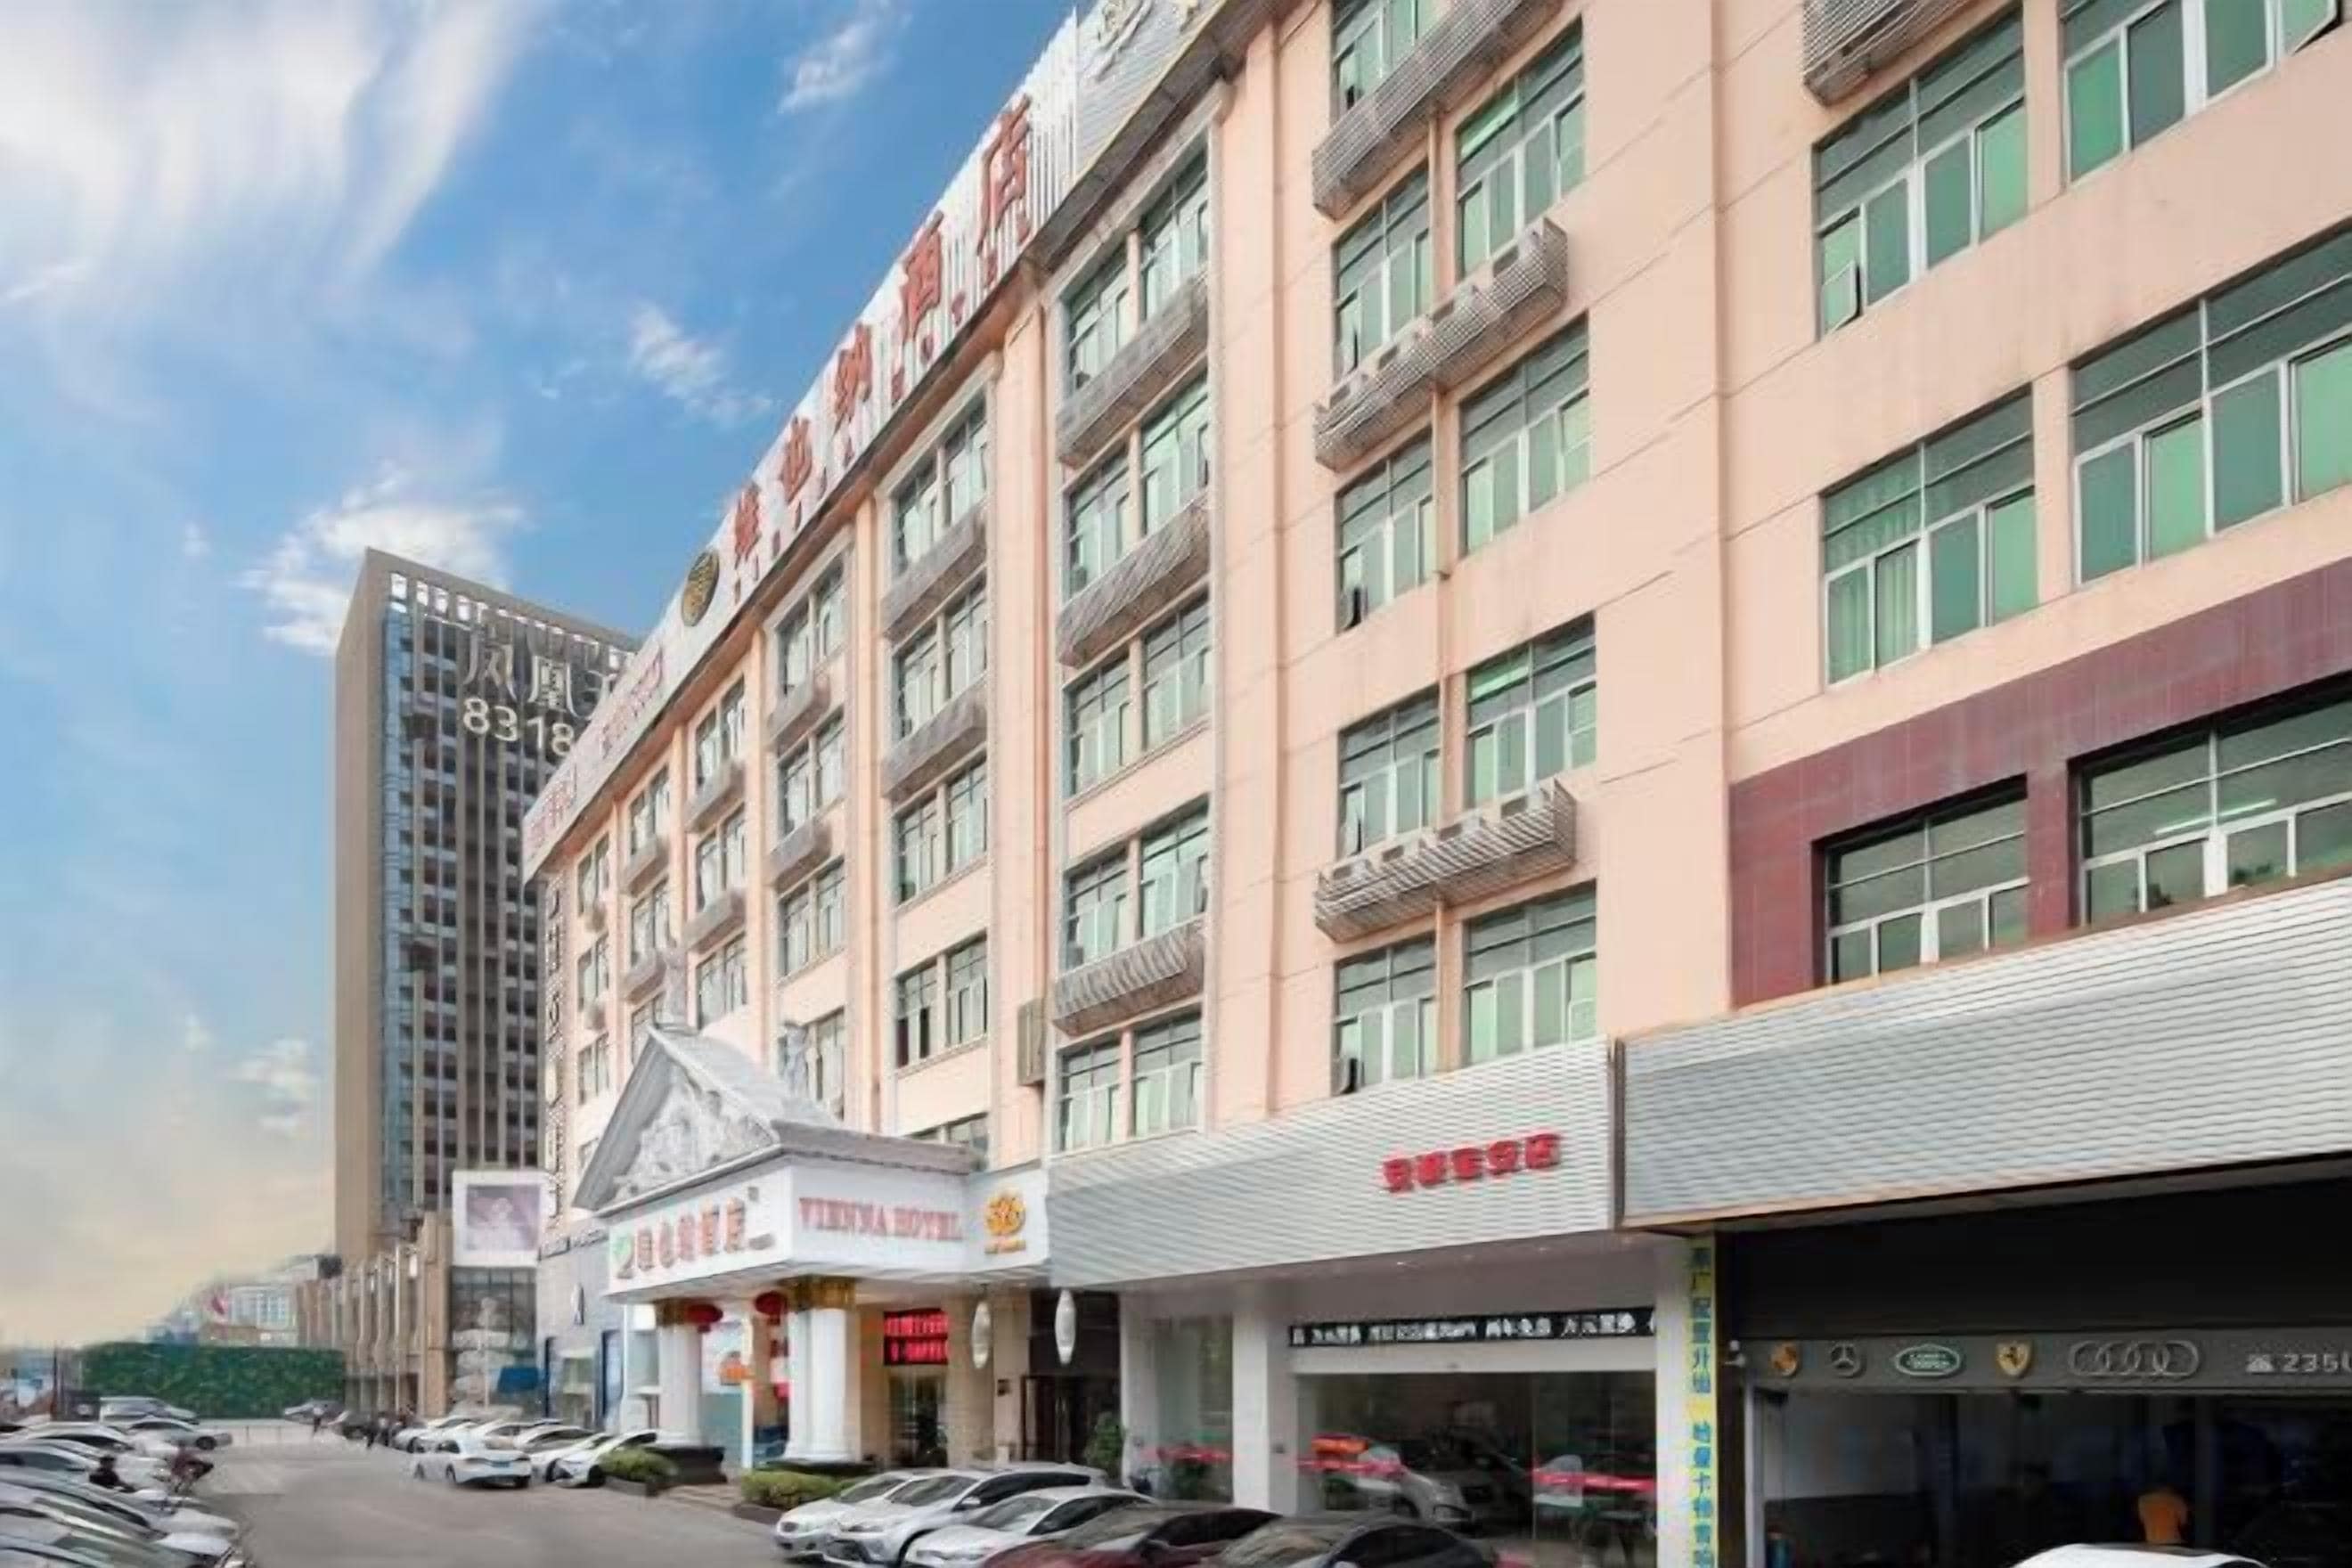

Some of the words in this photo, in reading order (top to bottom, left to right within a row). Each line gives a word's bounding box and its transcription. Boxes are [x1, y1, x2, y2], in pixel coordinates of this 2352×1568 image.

[734, 94, 1031, 563] 维也纳酒店
